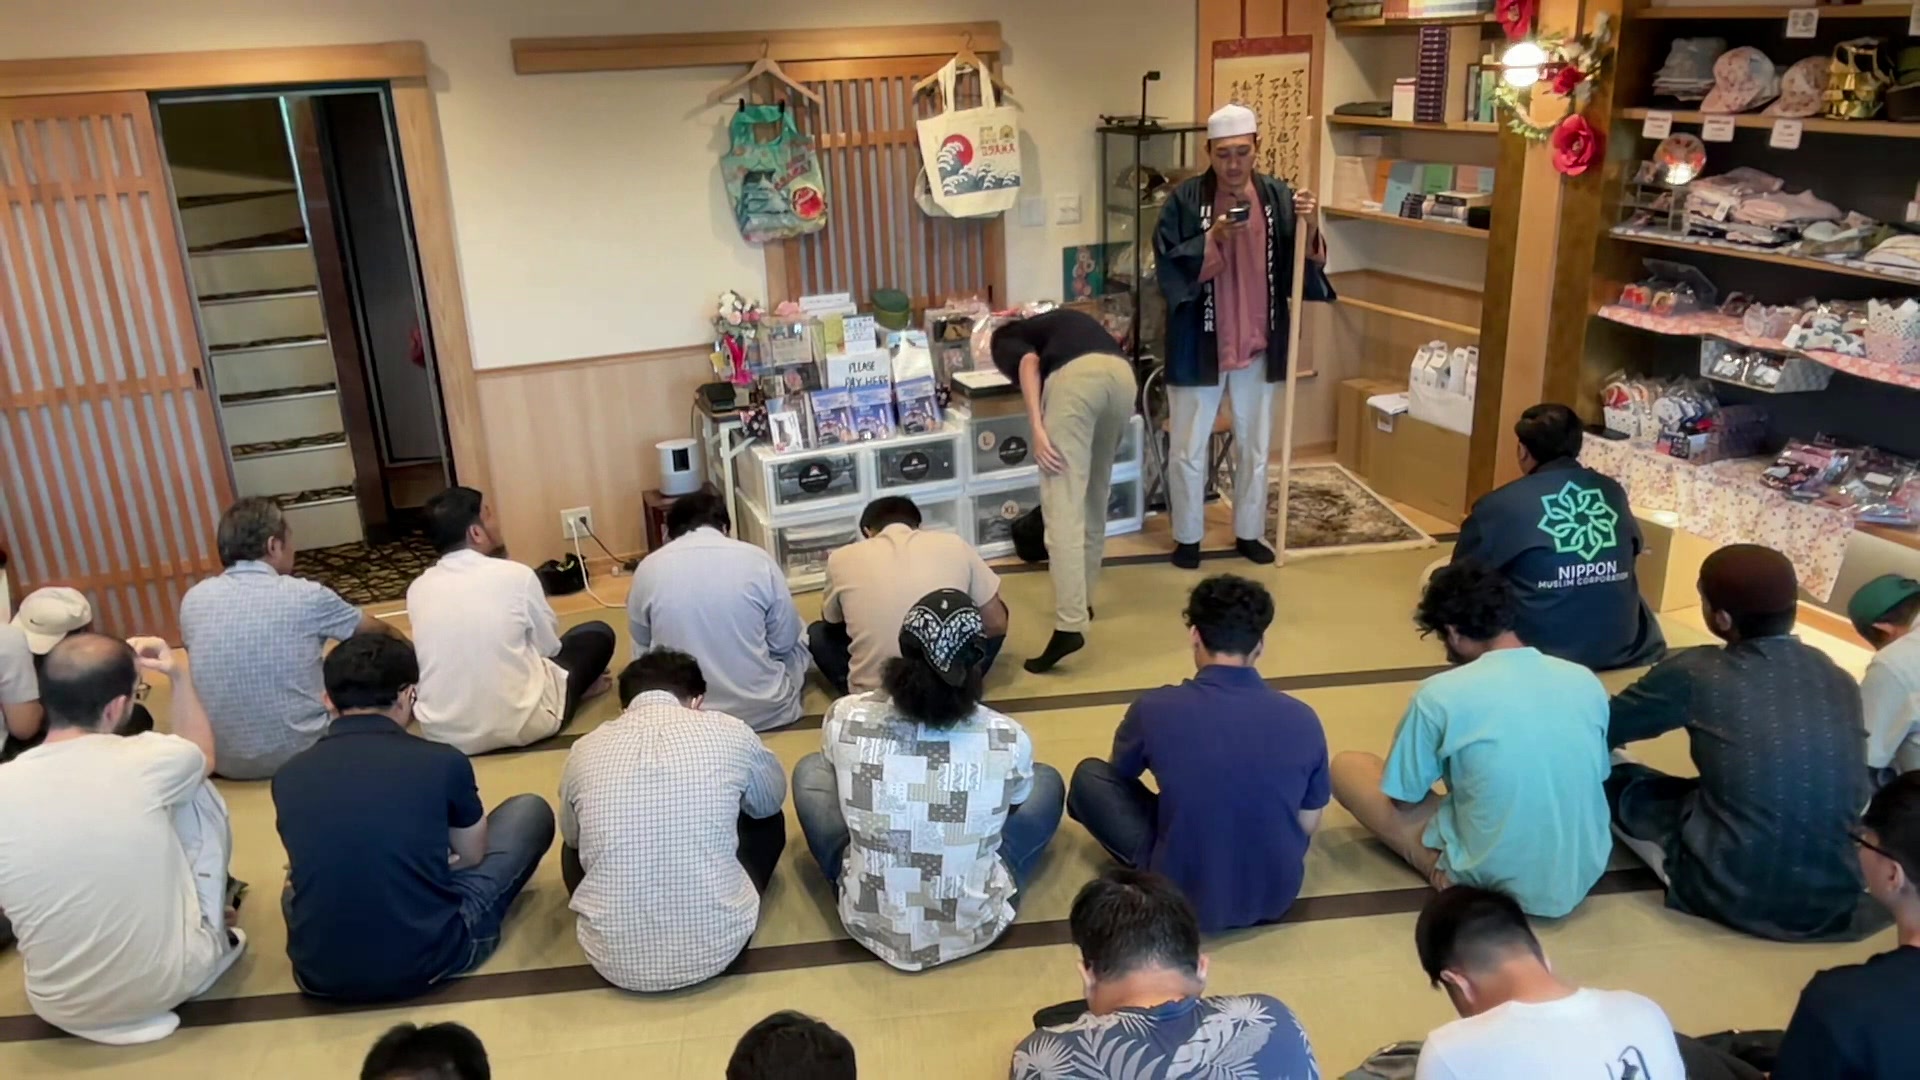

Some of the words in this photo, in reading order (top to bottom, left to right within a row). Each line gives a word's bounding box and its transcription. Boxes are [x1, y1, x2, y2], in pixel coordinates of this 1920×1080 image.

[848, 360, 876, 374] PLEASE
[845, 377, 862, 387] PAY
[1003, 504, 1017, 514] XL
[1558, 561, 1617, 579] NIPPON
[1538, 579, 1574, 588] MUSLIM
[1576, 572, 1628, 586] CORPORATION
